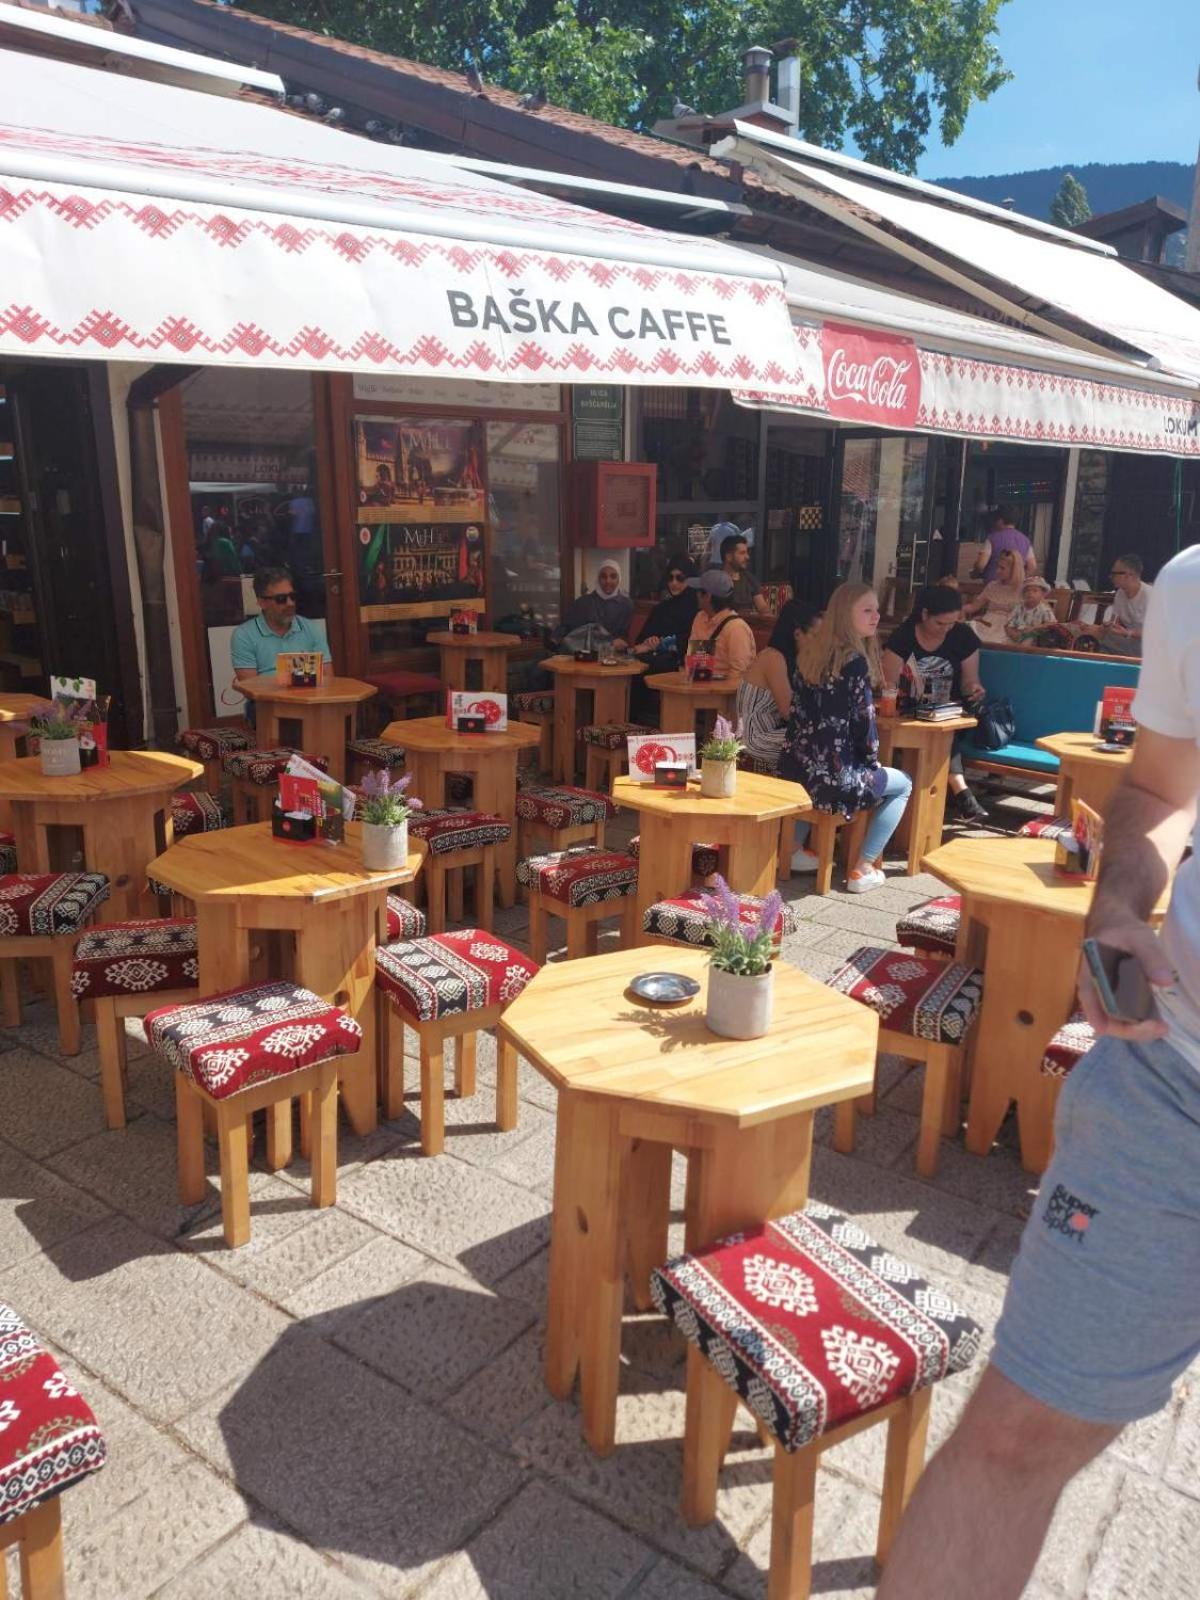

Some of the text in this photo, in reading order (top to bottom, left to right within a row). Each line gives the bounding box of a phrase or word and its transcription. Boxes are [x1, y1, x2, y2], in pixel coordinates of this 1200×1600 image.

[446, 288, 732, 346] BAŠKA CAFFE
[1163, 415, 1198, 437] LOKUM
